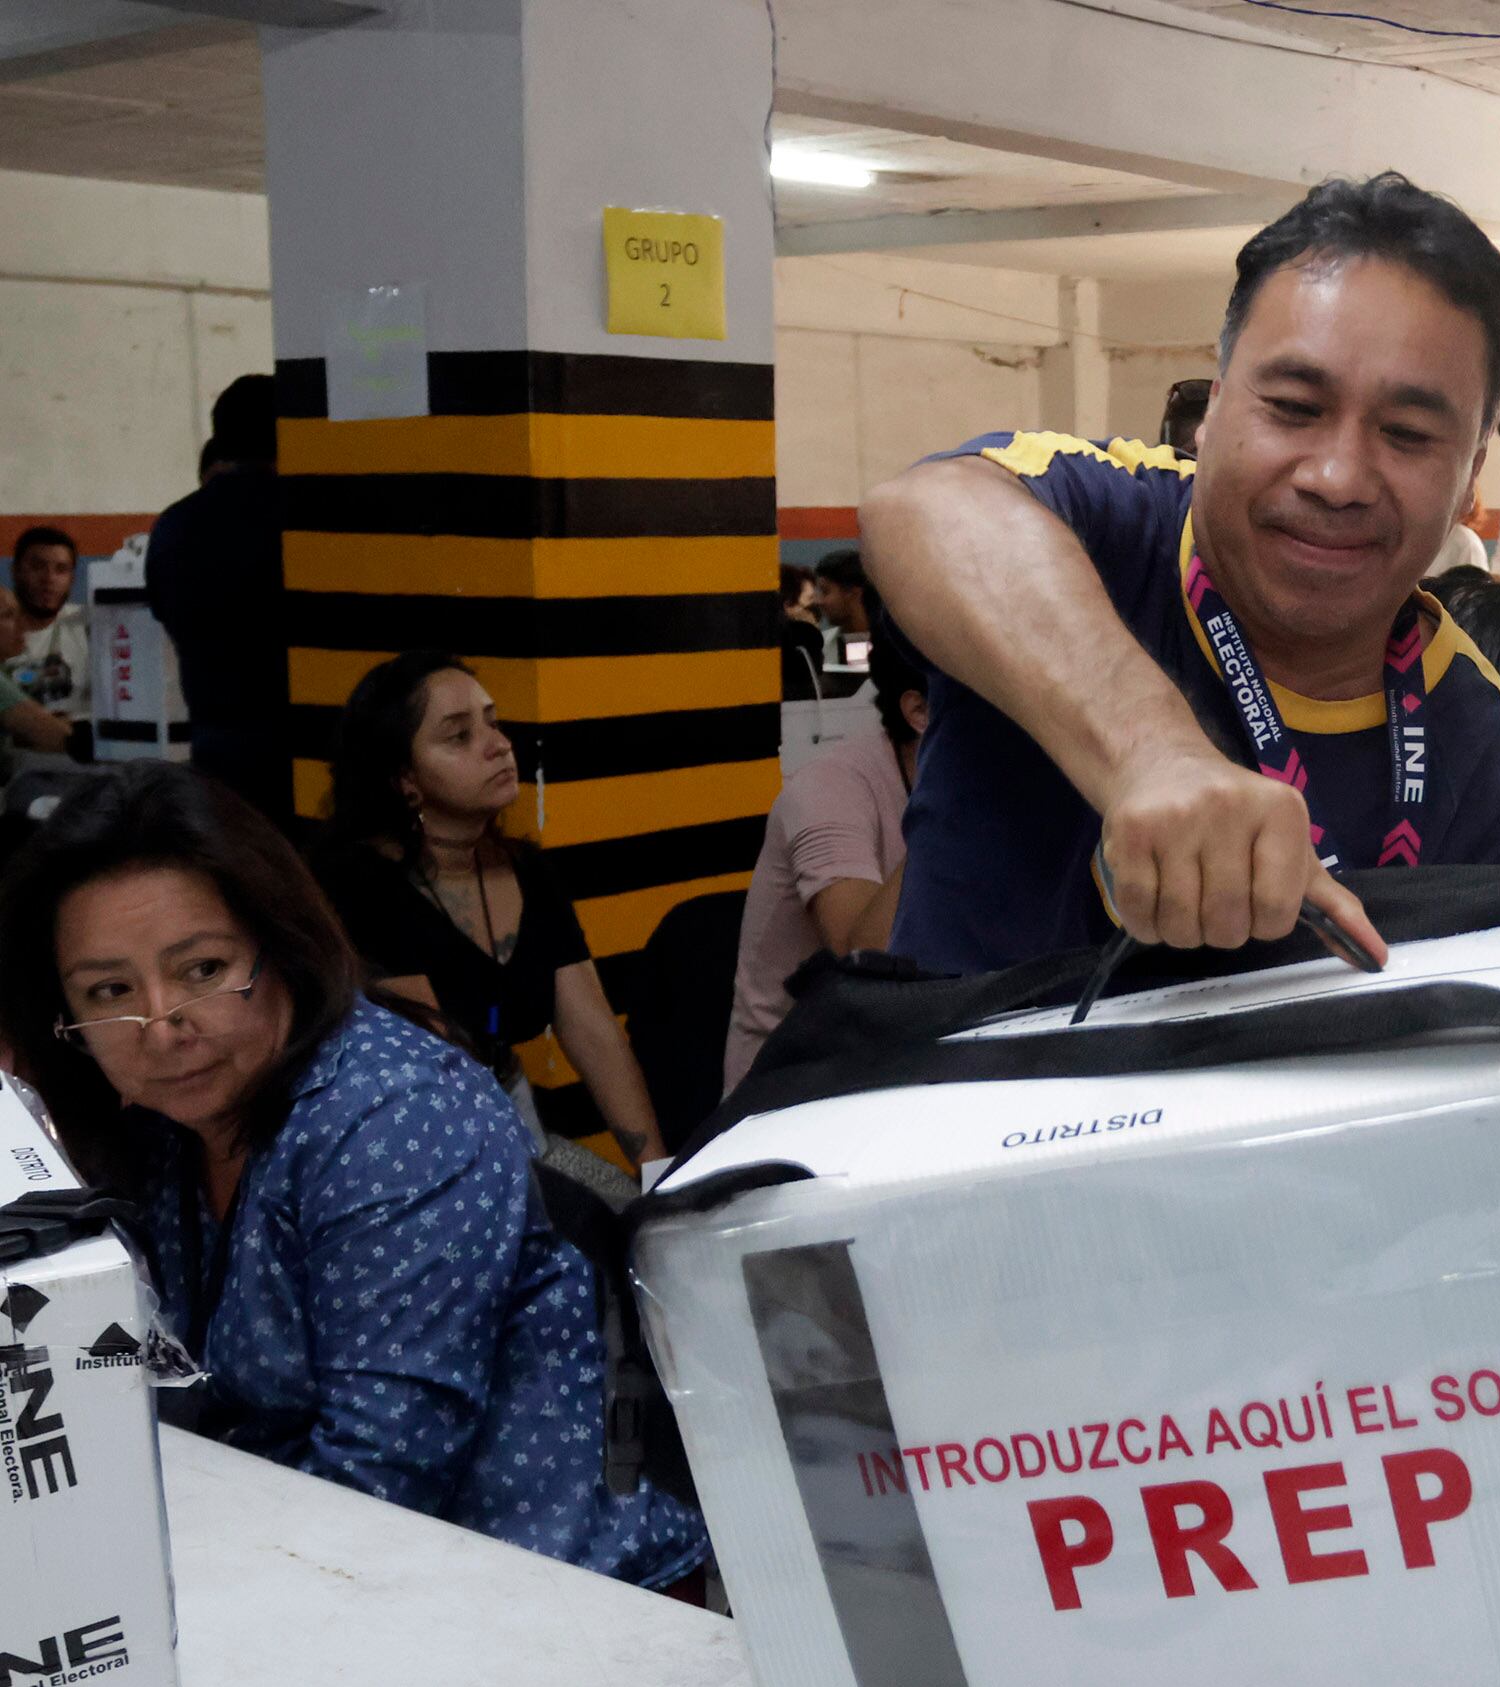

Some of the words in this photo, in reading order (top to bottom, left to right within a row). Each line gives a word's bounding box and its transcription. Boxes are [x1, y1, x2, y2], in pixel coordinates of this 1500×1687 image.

[624, 237, 699, 266] GRUPO
[660, 283, 671, 307] 2
[1207, 615, 1271, 750] ELECTORAL
[1222, 611, 1256, 680] INSTITUTO
[1251, 679, 1282, 743] NACIONAL
[1403, 726, 1425, 803] INE
[10, 1147, 52, 1181] DISTRITO
[1001, 1108, 1163, 1148] DISTRITO
[858, 1415, 1193, 1497] INTRODUZCA
[1206, 1380, 1333, 1455] AQUÍ
[1347, 1385, 1419, 1434] EL
[1026, 1447, 1473, 1612] PREP
[0, 1615, 127, 1687] NE
[50, 1654, 129, 1687] Electoral
